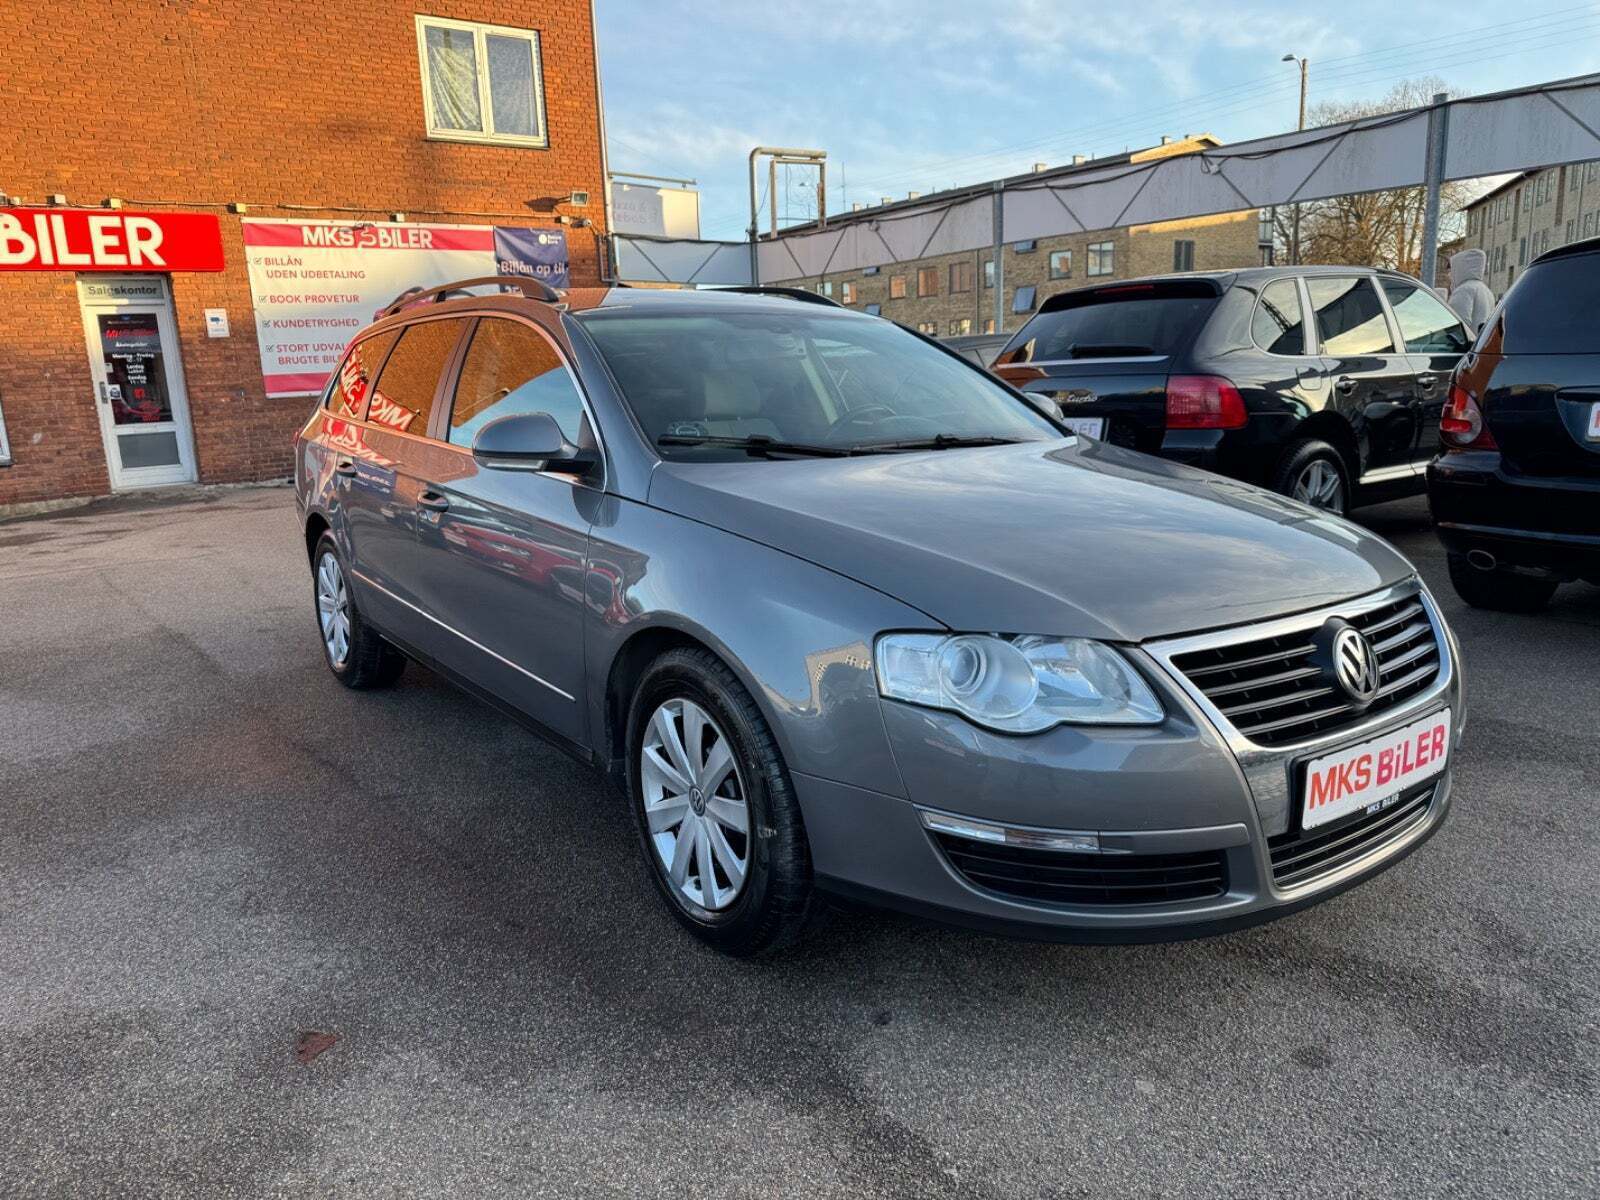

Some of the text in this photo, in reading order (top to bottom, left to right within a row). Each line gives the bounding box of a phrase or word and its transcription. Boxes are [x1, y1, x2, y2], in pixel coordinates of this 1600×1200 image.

[0, 212, 166, 266] BILER
[302, 226, 432, 248] MKS BILER
[264, 255, 303, 266] BILLÅN
[501, 260, 565, 277] Billån op til
[266, 270, 366, 280] UDEN UDBETALING
[269, 294, 360, 304] BOOK PRØVETUR
[273, 319, 360, 329] KUNDETRYGHED
[276, 343, 346, 353] STORT UDVAL
[278, 355, 337, 365] BRUGTE BIL
[1309, 754, 1372, 810] MKS
